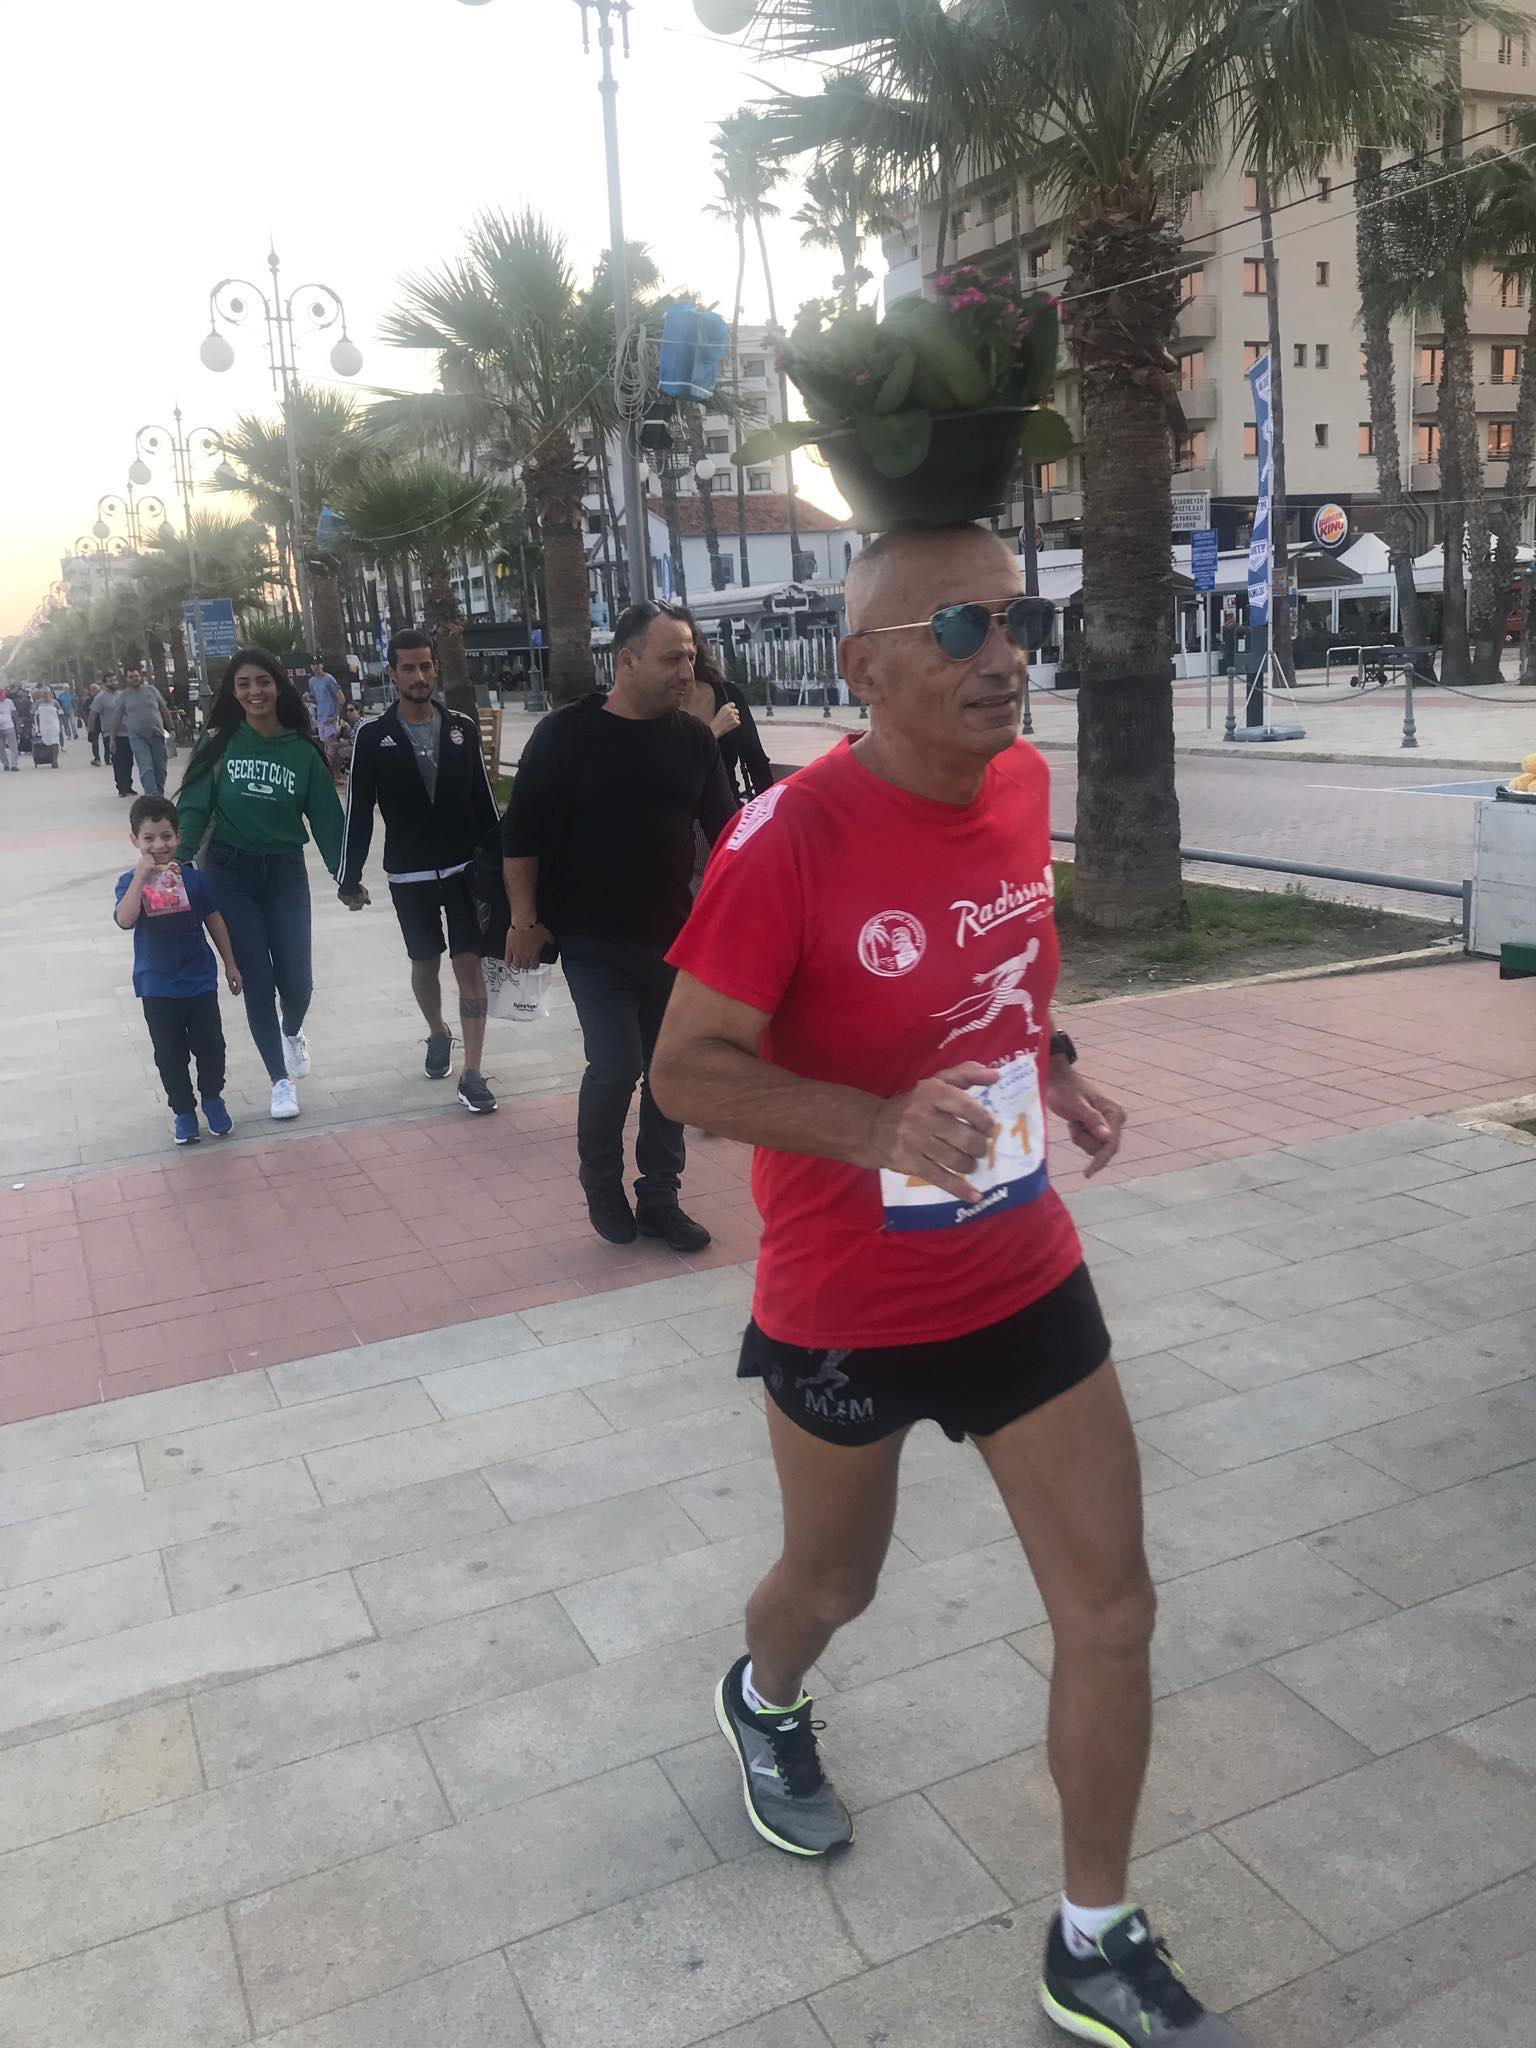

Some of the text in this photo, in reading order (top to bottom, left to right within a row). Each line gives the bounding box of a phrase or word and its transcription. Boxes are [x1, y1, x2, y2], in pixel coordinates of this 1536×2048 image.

[1319, 512, 1343, 529] BURGER
[1320, 520, 1344, 538] KING
[227, 759, 295, 795] SECRET COVE
